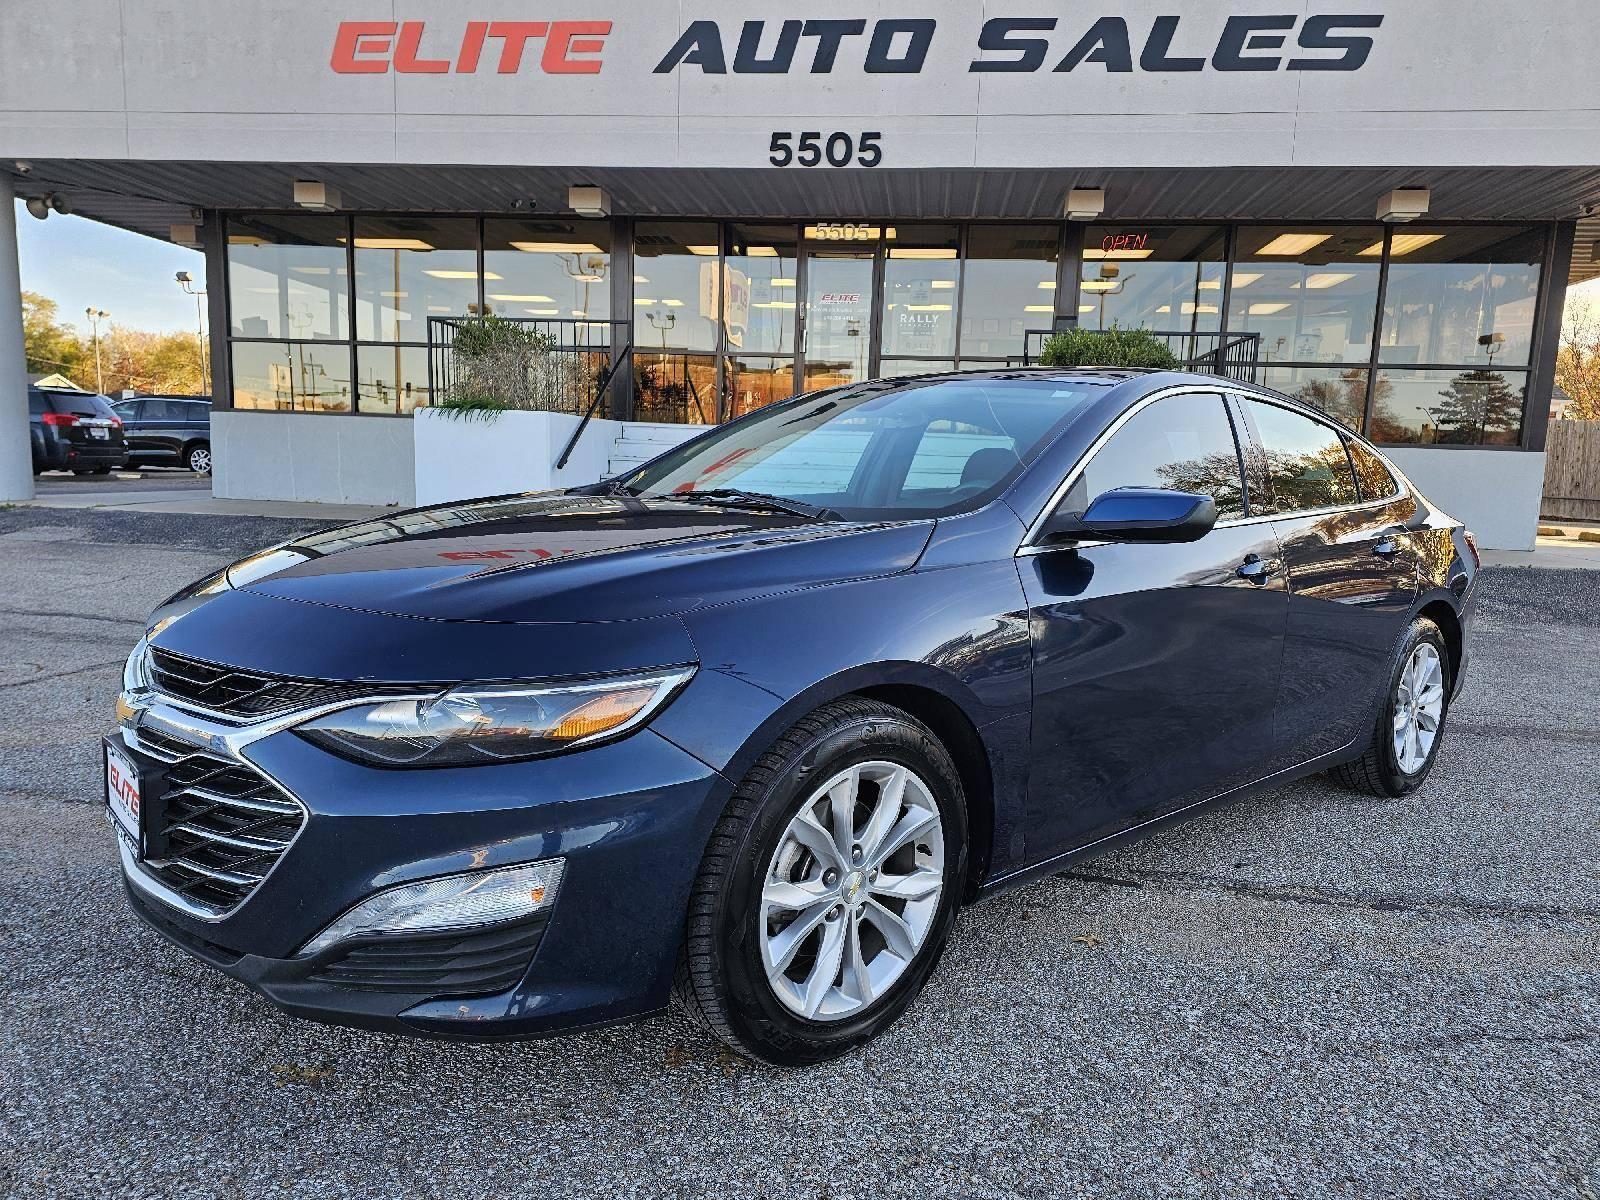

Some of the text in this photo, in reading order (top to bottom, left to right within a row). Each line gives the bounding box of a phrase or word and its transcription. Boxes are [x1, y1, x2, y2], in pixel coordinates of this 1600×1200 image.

[330, 14, 1385, 75] ELITE AUTO SALES
[769, 131, 882, 168] 5505
[815, 222, 870, 241] 5505
[1102, 233, 1148, 252] OPEN
[899, 313, 940, 323] RALLY
[110, 763, 141, 818] ELITE
